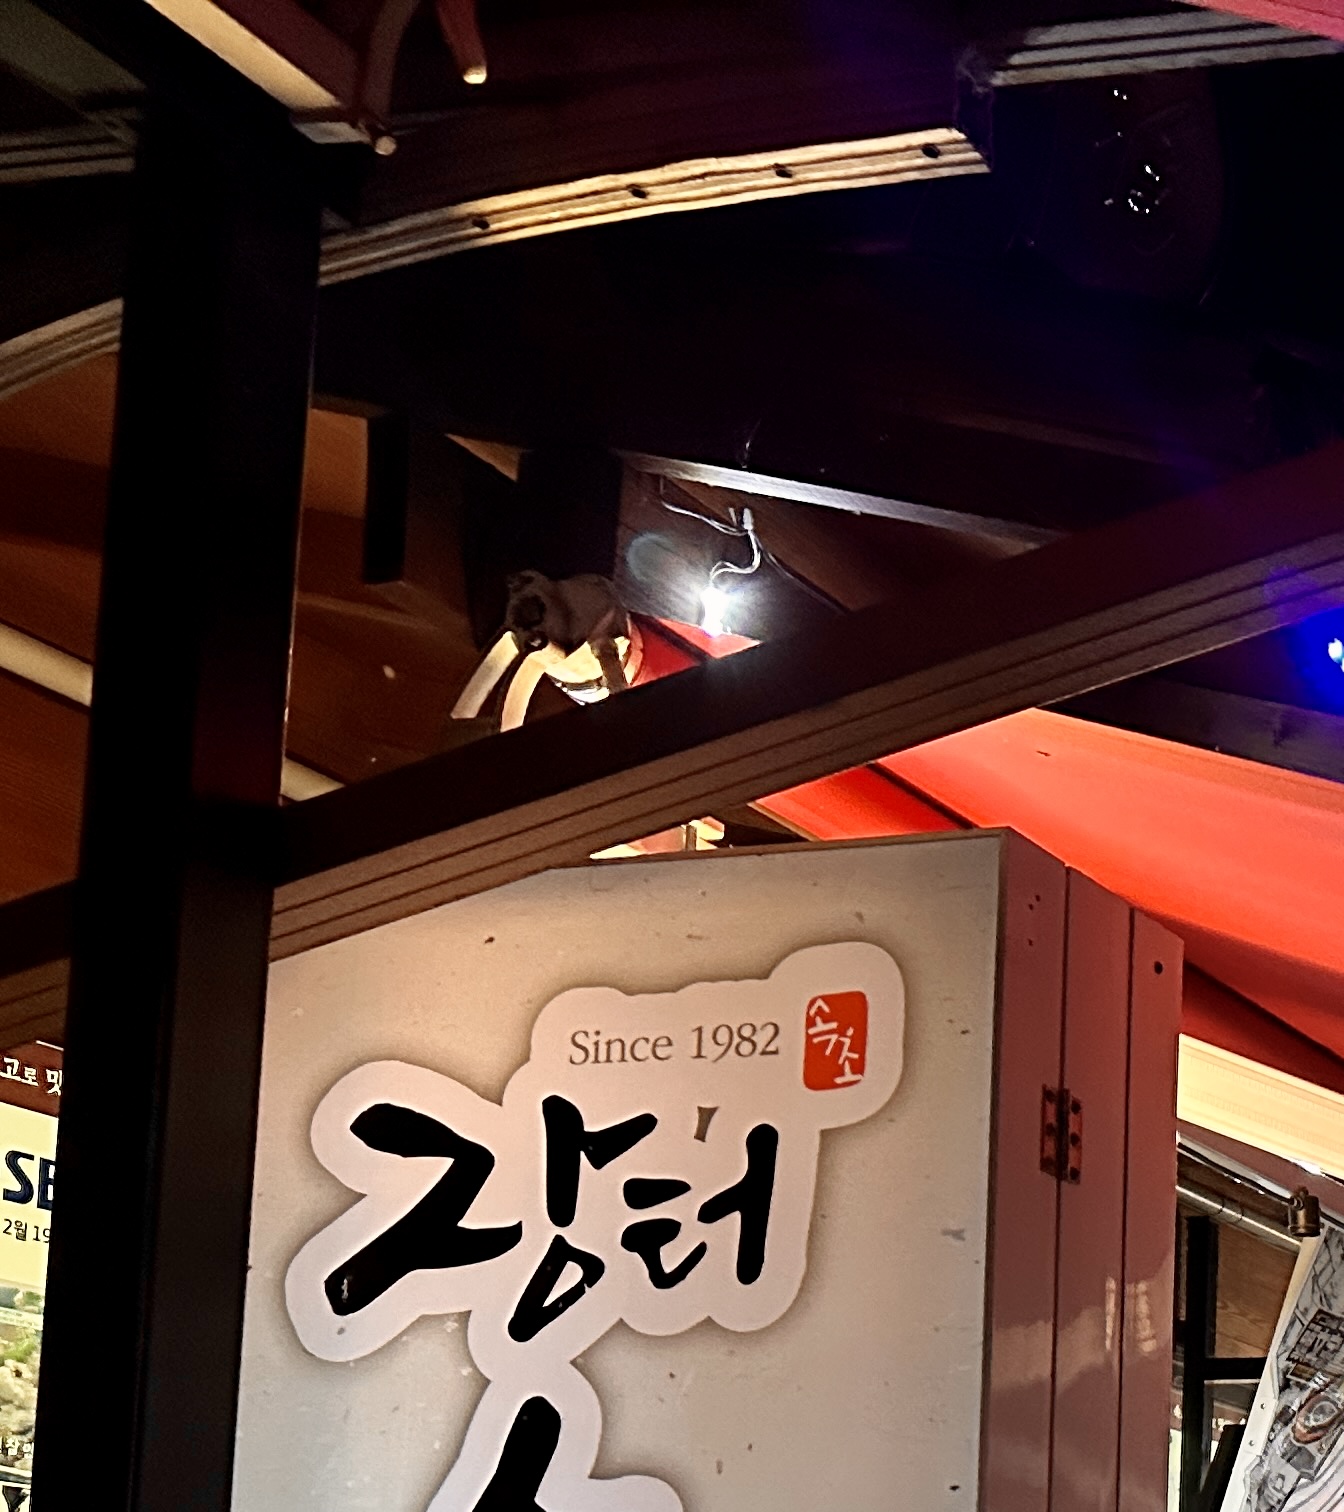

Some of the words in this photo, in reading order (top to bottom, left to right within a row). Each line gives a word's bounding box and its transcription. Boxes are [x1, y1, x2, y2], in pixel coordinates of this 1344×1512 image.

[568, 1029, 674, 1065] Since
[691, 1022, 781, 1060] 1982
[324, 1094, 780, 1343] 장터
